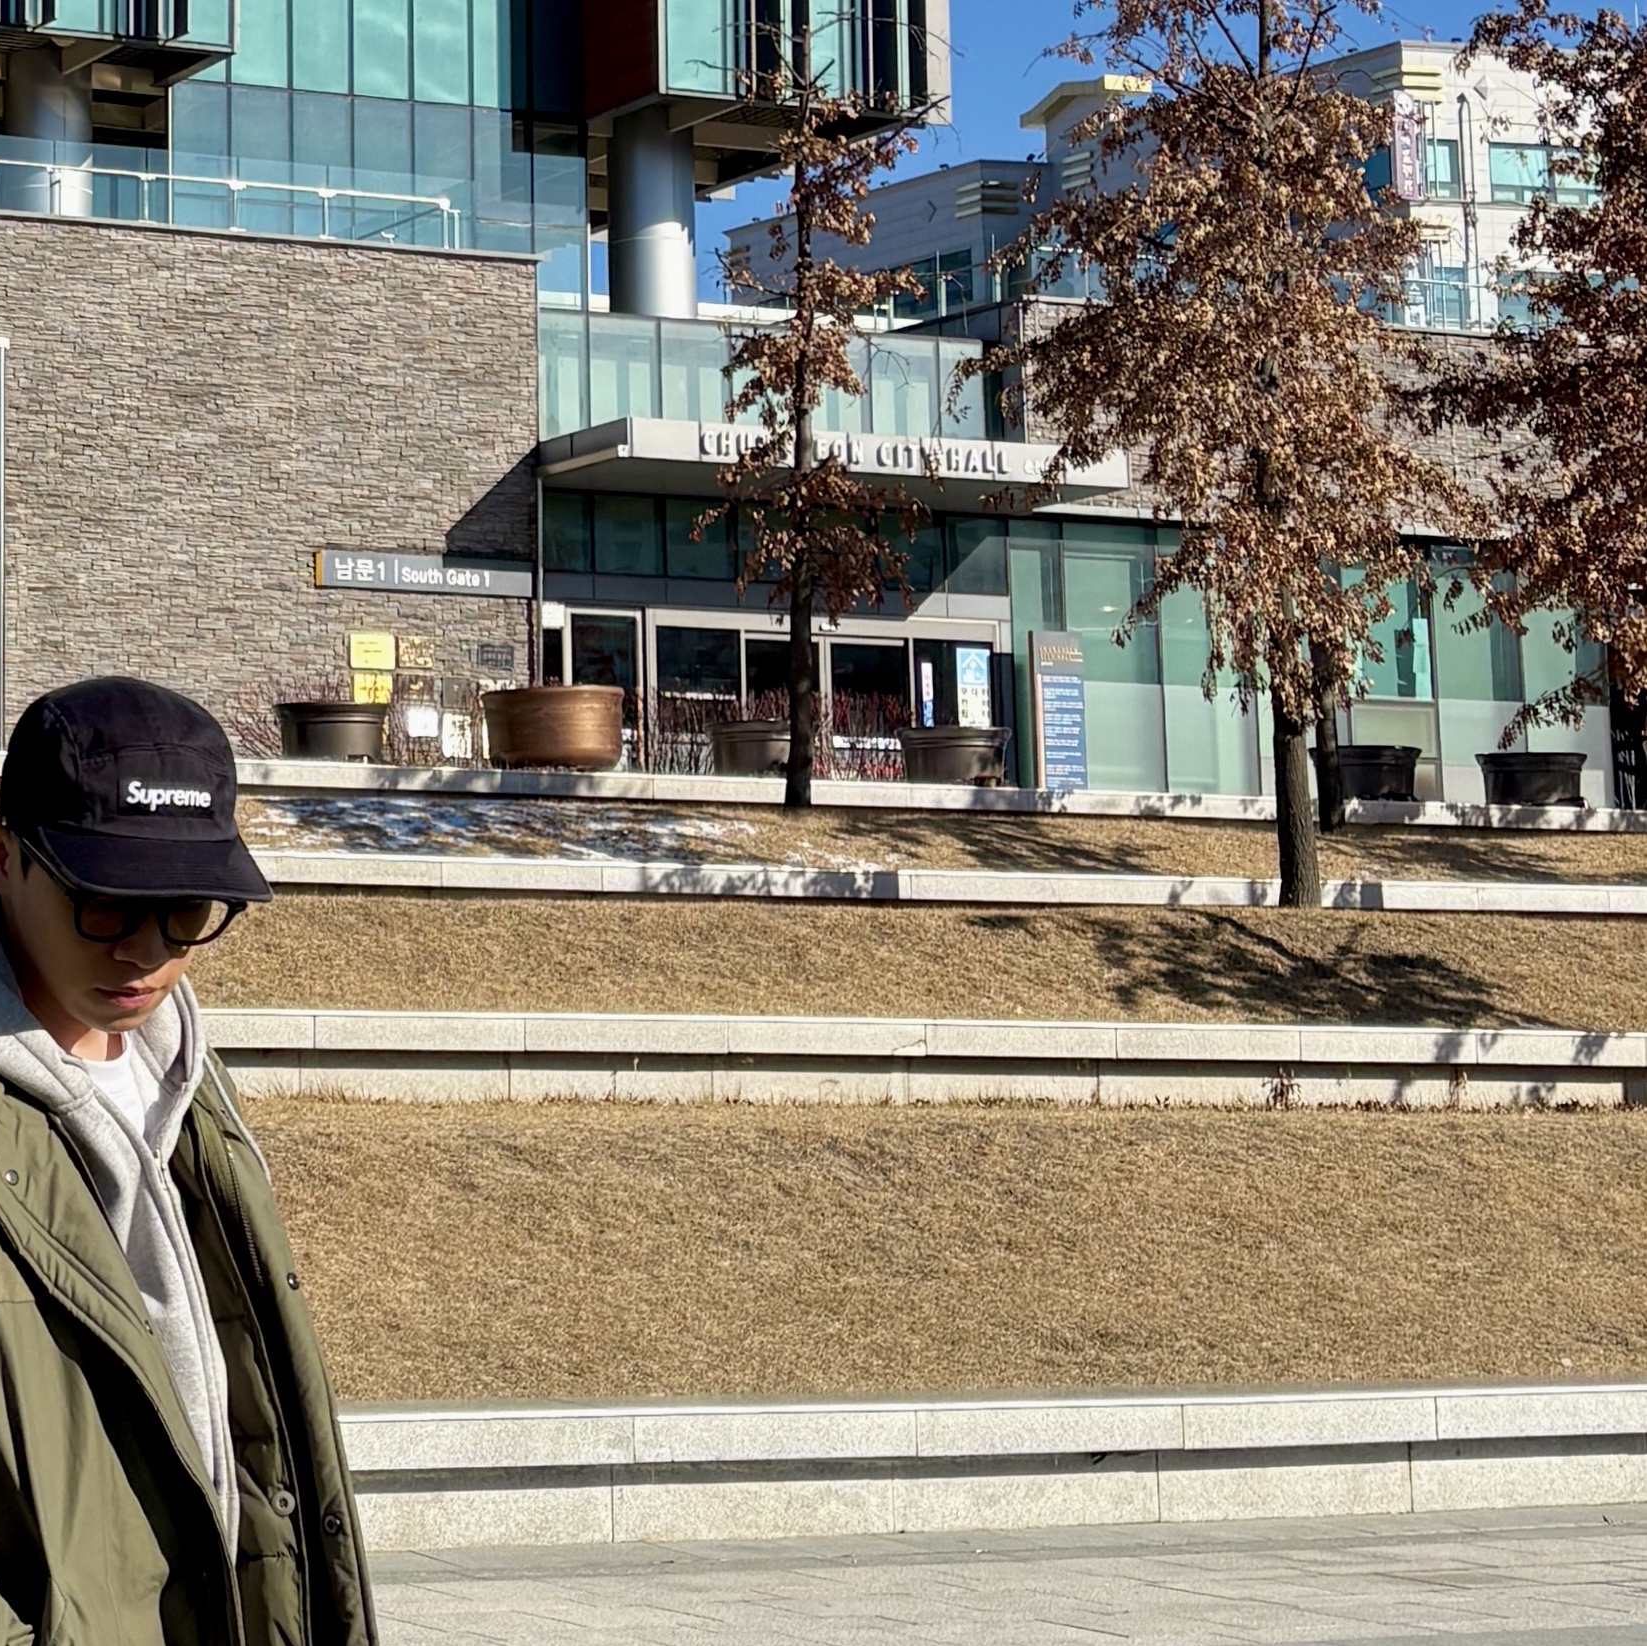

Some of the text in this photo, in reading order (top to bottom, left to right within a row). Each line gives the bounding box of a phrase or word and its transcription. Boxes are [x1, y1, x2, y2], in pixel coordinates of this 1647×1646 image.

[947, 447, 1011, 475] HALL
[401, 566, 490, 588] South Gate 1
[126, 780, 212, 812] Supreme
